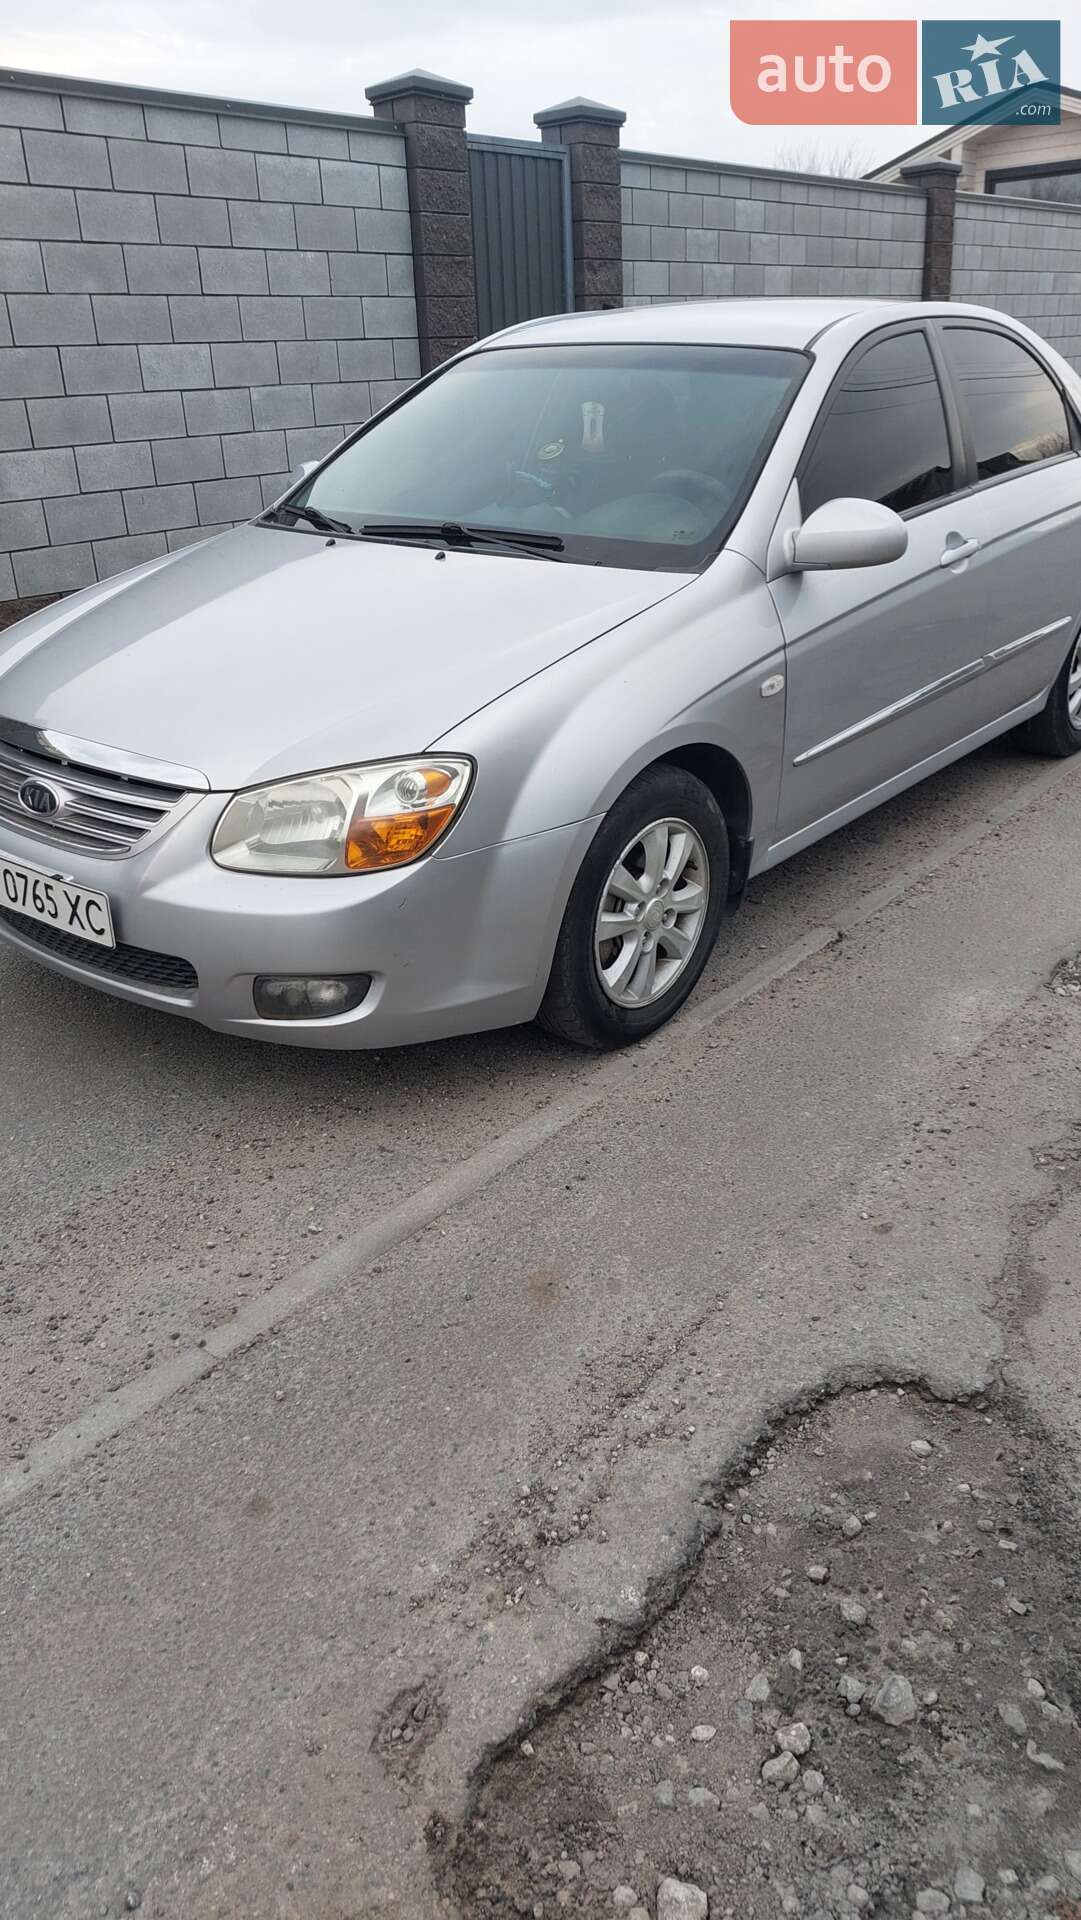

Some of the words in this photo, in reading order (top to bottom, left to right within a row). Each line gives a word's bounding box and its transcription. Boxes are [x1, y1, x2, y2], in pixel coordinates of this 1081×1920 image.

[23, 785, 52, 814] KIA
[3, 868, 58, 919] 0765
[63, 890, 105, 936] XC
